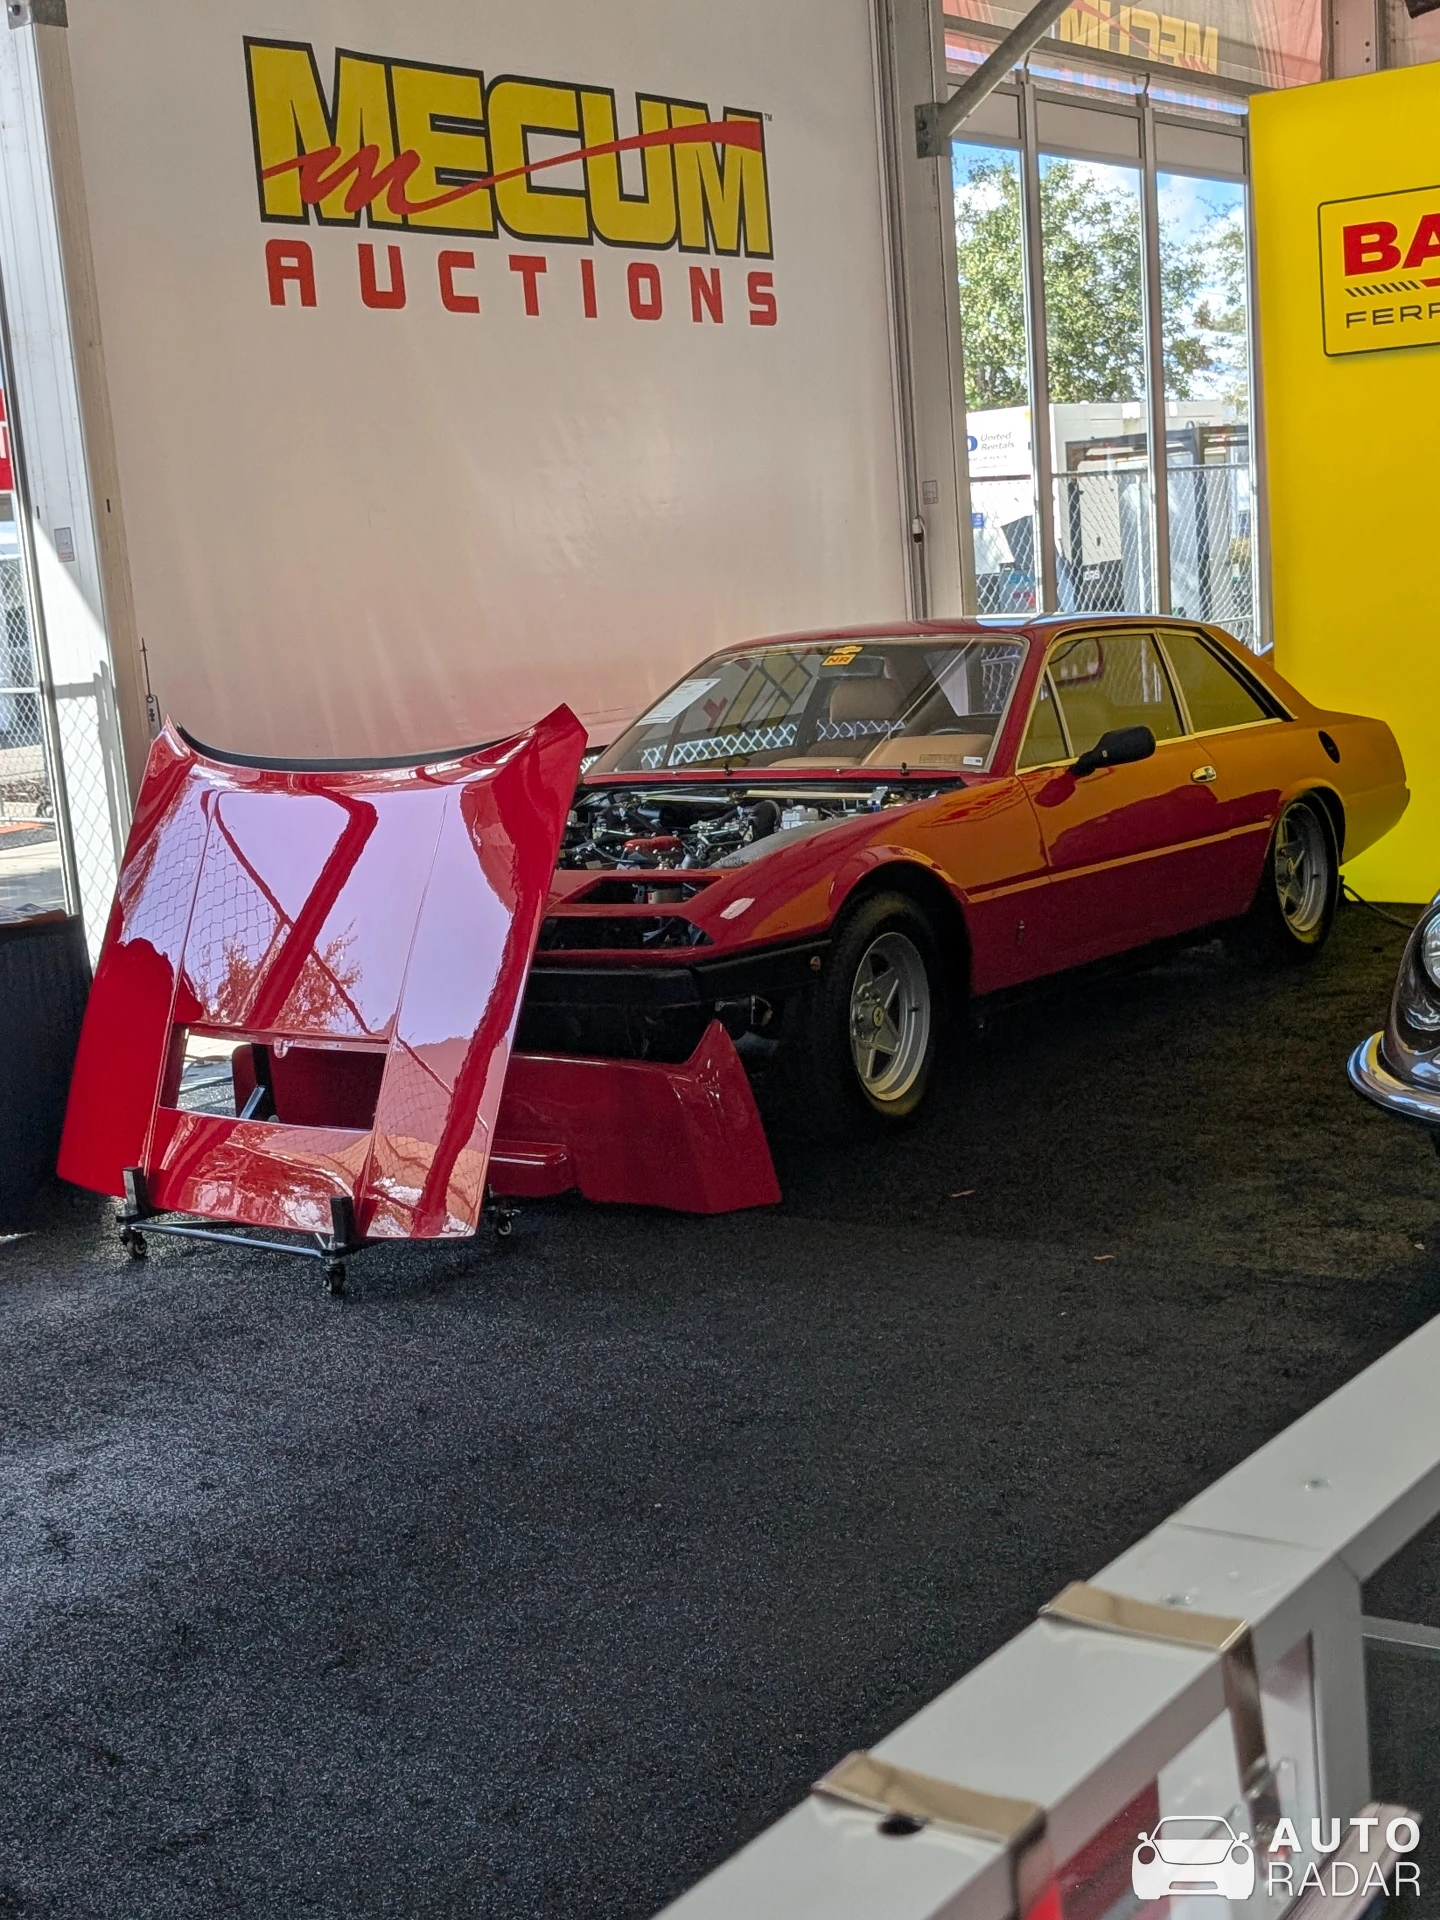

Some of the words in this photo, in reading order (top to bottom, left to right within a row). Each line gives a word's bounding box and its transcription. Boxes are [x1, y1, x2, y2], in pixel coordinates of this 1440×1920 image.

[243, 35, 774, 260] MECUM
[265, 238, 778, 326] AUCTIONS
[980, 431, 1012, 442] United
[981, 440, 1015, 450] Rentals
